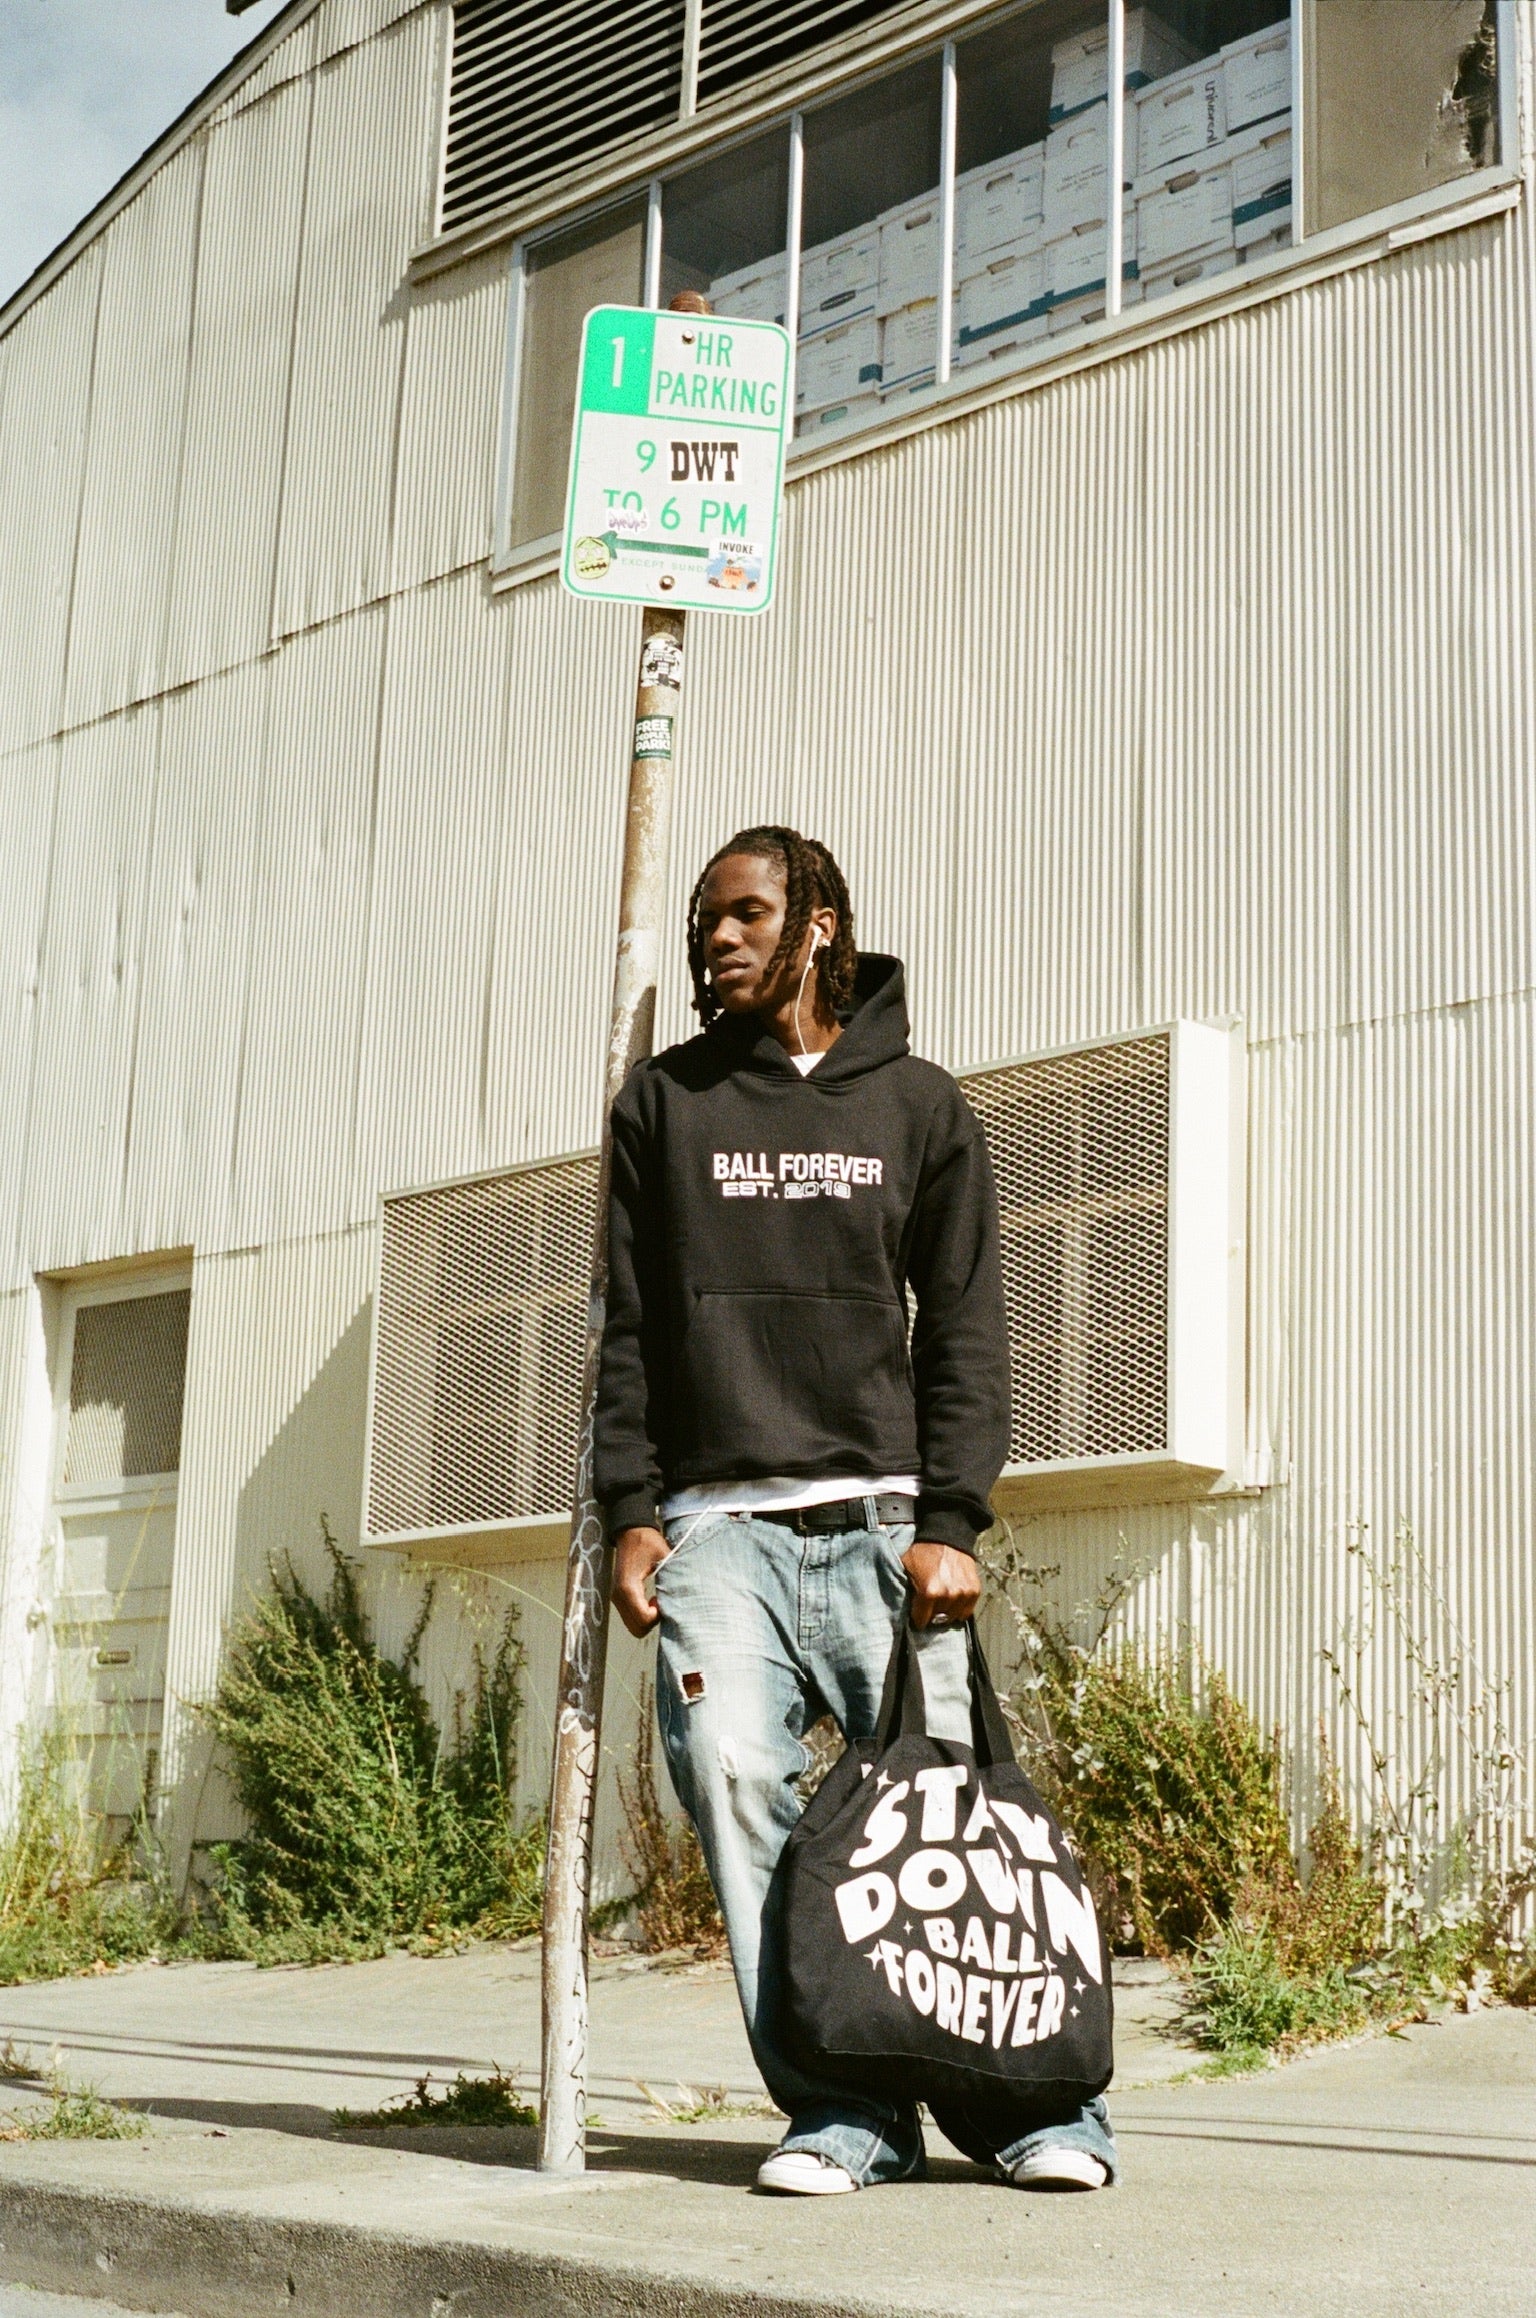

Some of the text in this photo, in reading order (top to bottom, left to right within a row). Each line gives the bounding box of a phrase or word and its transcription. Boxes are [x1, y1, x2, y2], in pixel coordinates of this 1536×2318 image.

[611, 331, 733, 388] 1 HR
[655, 370, 777, 417] PARKING
[636, 440, 657, 473] 9
[670, 441, 740, 483] DWT
[660, 496, 681, 531] 6
[699, 499, 748, 538] PM
[719, 542, 754, 555] INVOKE
[636, 718, 670, 736] FREE
[713, 1152, 884, 1186] BALL FOREVER
[722, 1179, 852, 1200] EST. 2019
[849, 1764, 1058, 1868] STAY
[834, 1848, 1104, 1985] DOWN
[922, 1915, 1045, 1974] BALL
[878, 1938, 1067, 2050] FOREVER
